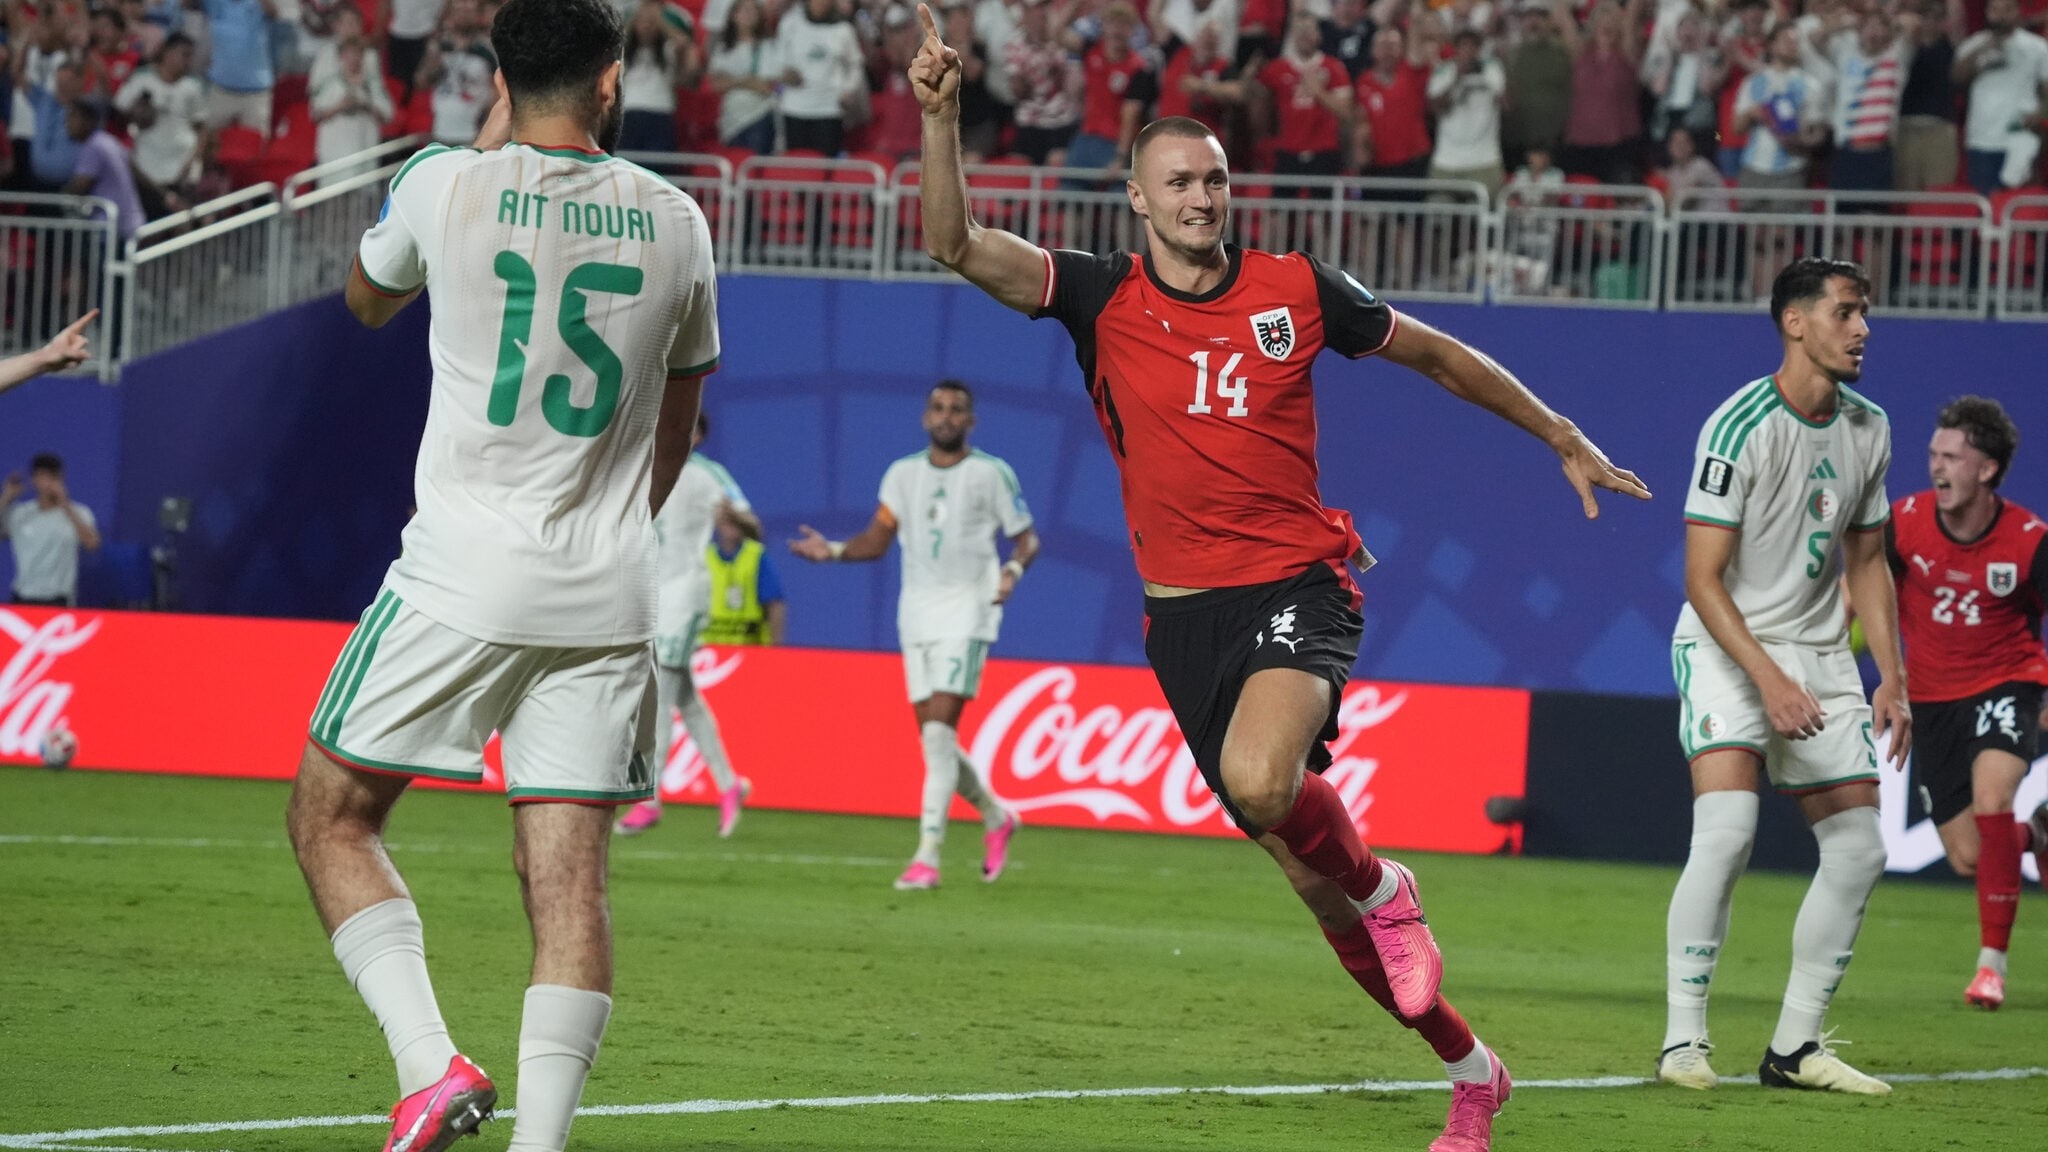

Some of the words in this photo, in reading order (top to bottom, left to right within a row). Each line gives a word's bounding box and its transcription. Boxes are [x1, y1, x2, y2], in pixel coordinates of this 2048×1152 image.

[498, 189, 549, 229] AIT
[487, 250, 644, 438] 15
[1187, 351, 1249, 417] 14
[929, 529, 944, 559] 7
[1806, 531, 1831, 579] 5
[1931, 586, 1982, 626] 24
[948, 656, 963, 686] 7
